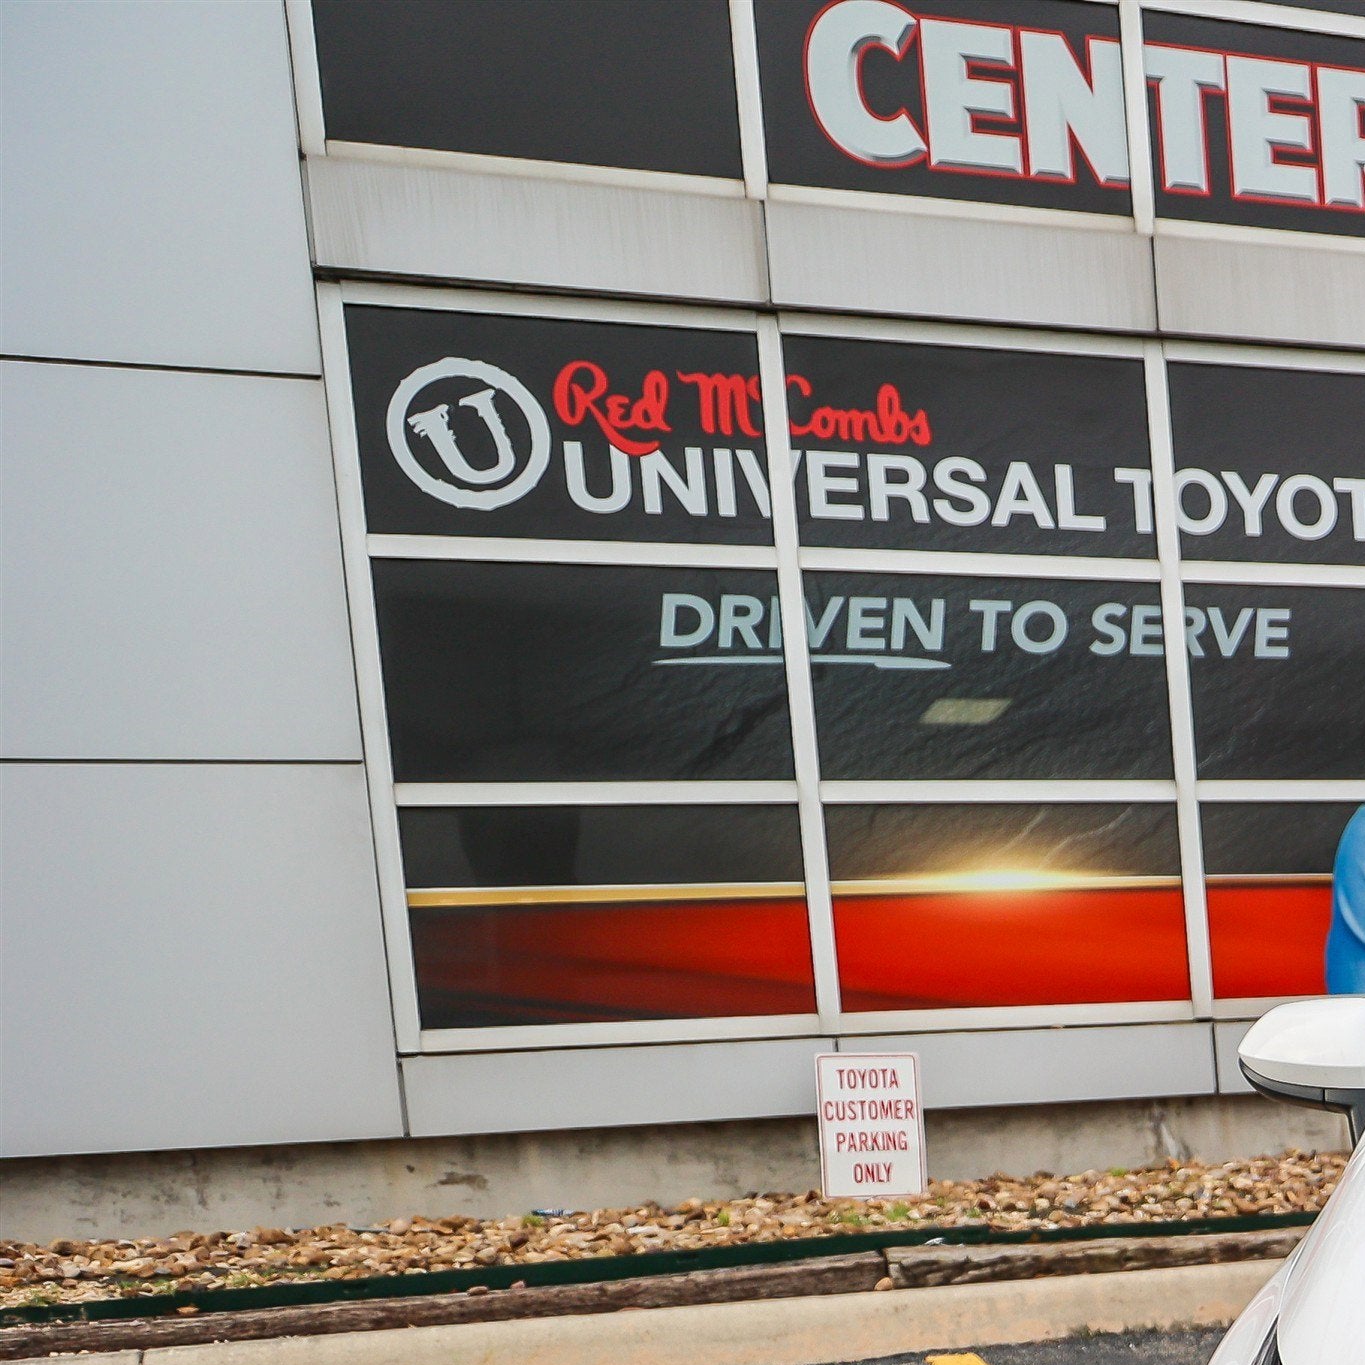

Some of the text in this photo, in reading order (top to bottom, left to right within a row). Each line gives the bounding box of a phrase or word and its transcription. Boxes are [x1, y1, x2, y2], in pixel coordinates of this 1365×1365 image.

[553, 360, 671, 456] Red
[563, 441, 1106, 532] UNIVERSAL
[659, 593, 1291, 659] DRIVEN TO SERVE
[835, 1068, 899, 1090] TOYOTA
[823, 1099, 915, 1121] CUSTOMER
[835, 1130, 909, 1152] PARKING
[852, 1161, 893, 1184] ONLY
